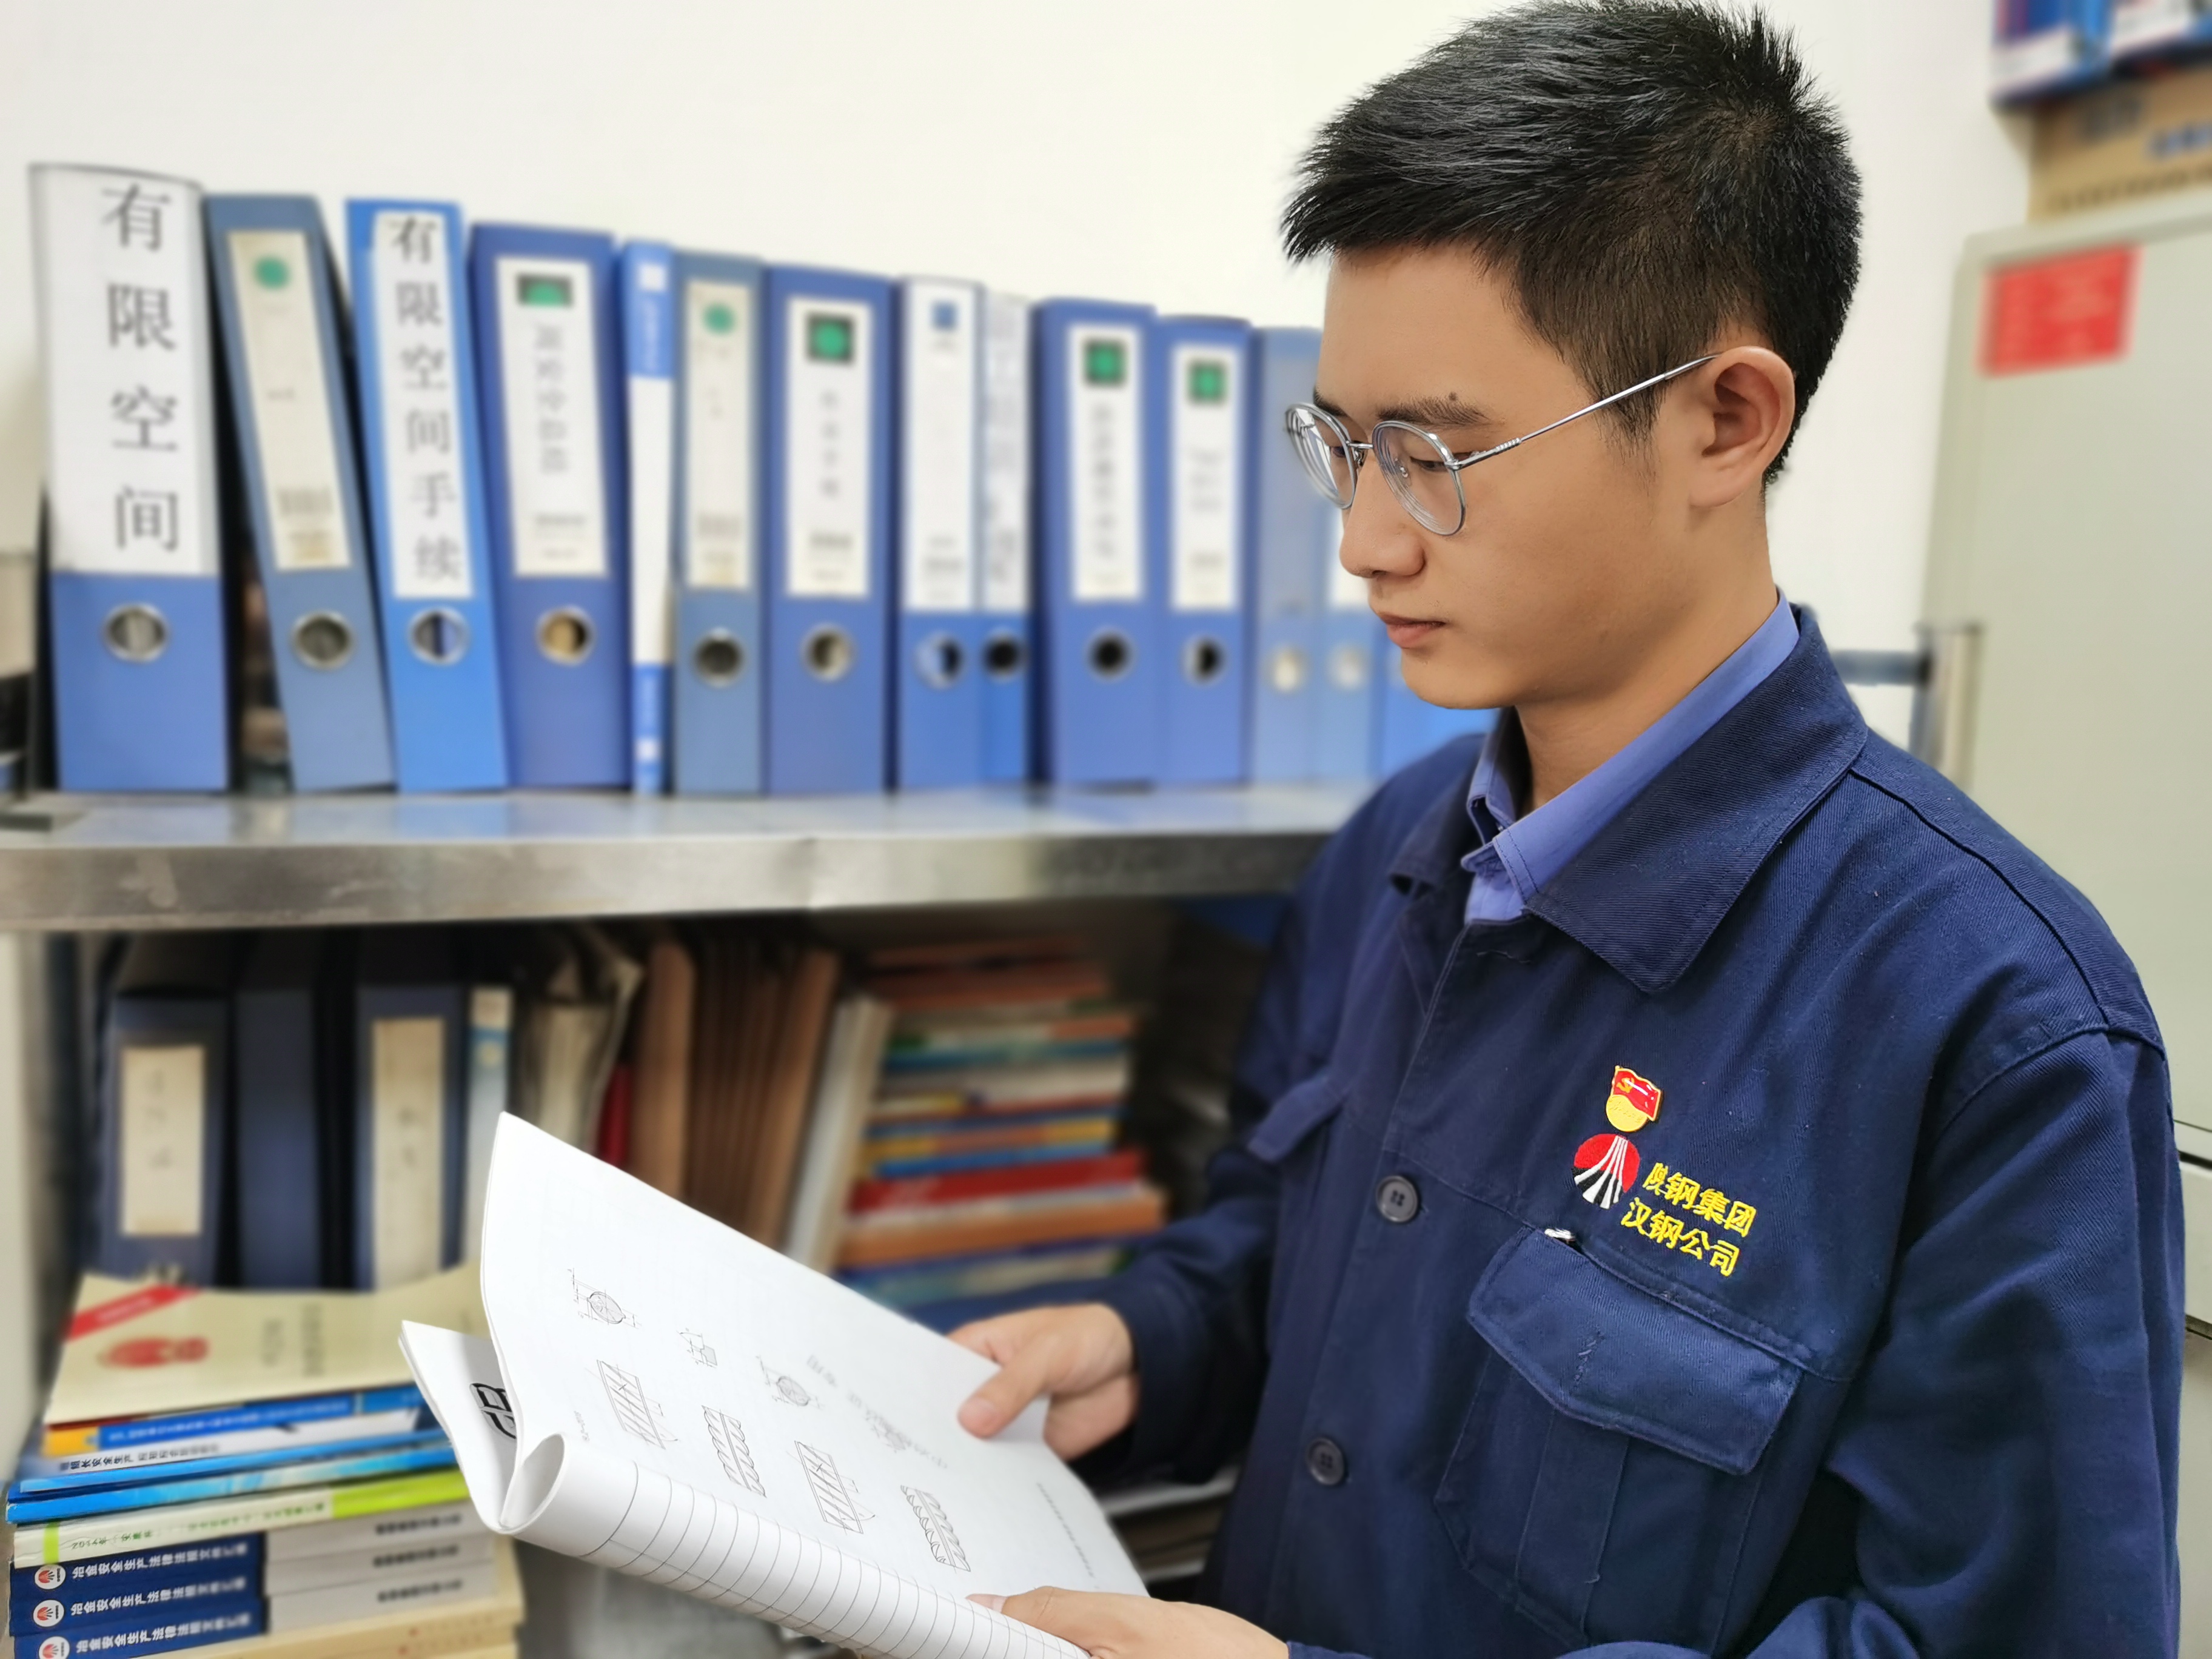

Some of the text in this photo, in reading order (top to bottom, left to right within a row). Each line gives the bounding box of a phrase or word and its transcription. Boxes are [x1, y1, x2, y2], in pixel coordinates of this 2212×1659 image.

[102, 184, 179, 554] 有限空间
[390, 216, 463, 583] 有限空间手续
[1621, 1197, 1740, 1277] 汉钢公司
[1642, 1162, 1757, 1238] 陕钢集团
